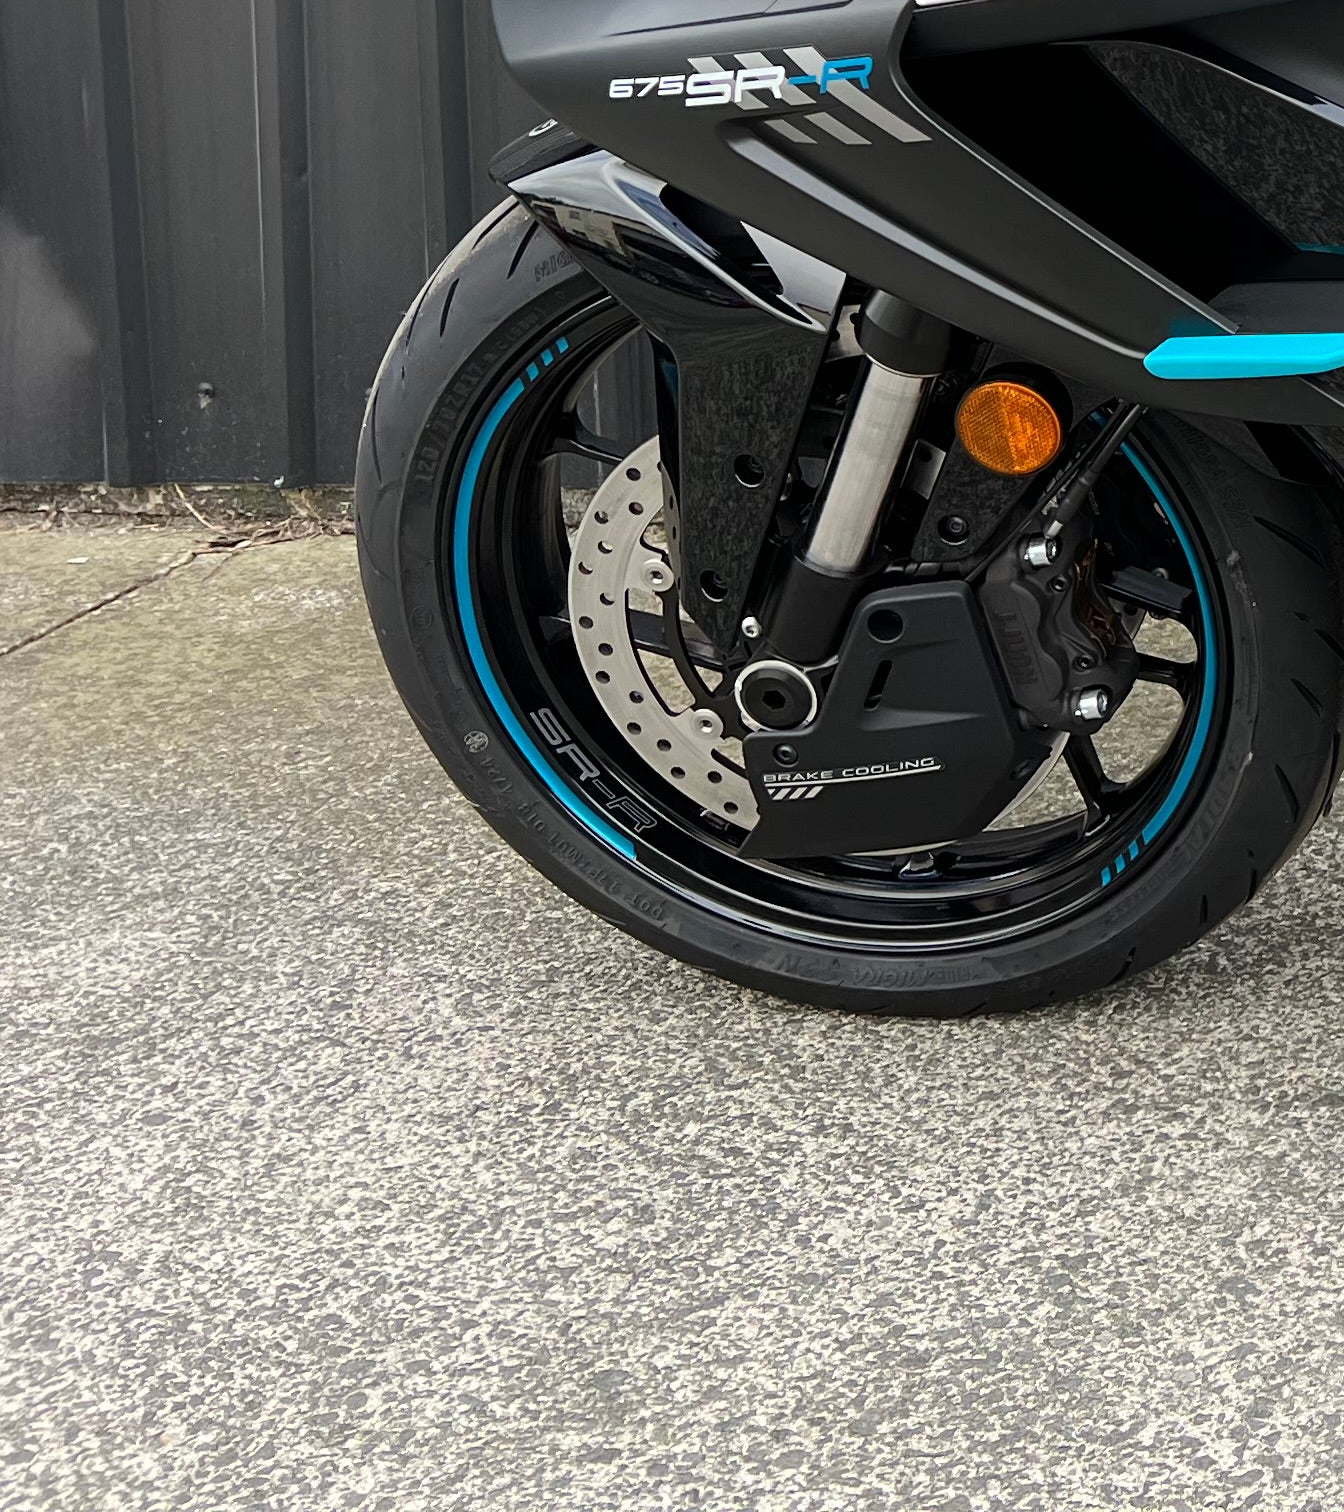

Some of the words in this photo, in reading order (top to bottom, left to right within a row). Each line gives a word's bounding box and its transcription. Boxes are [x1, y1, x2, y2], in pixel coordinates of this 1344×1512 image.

[530, 707, 658, 834] SR-R
[763, 769, 834, 783] BRAKE
[842, 757, 936, 777] COOLING
